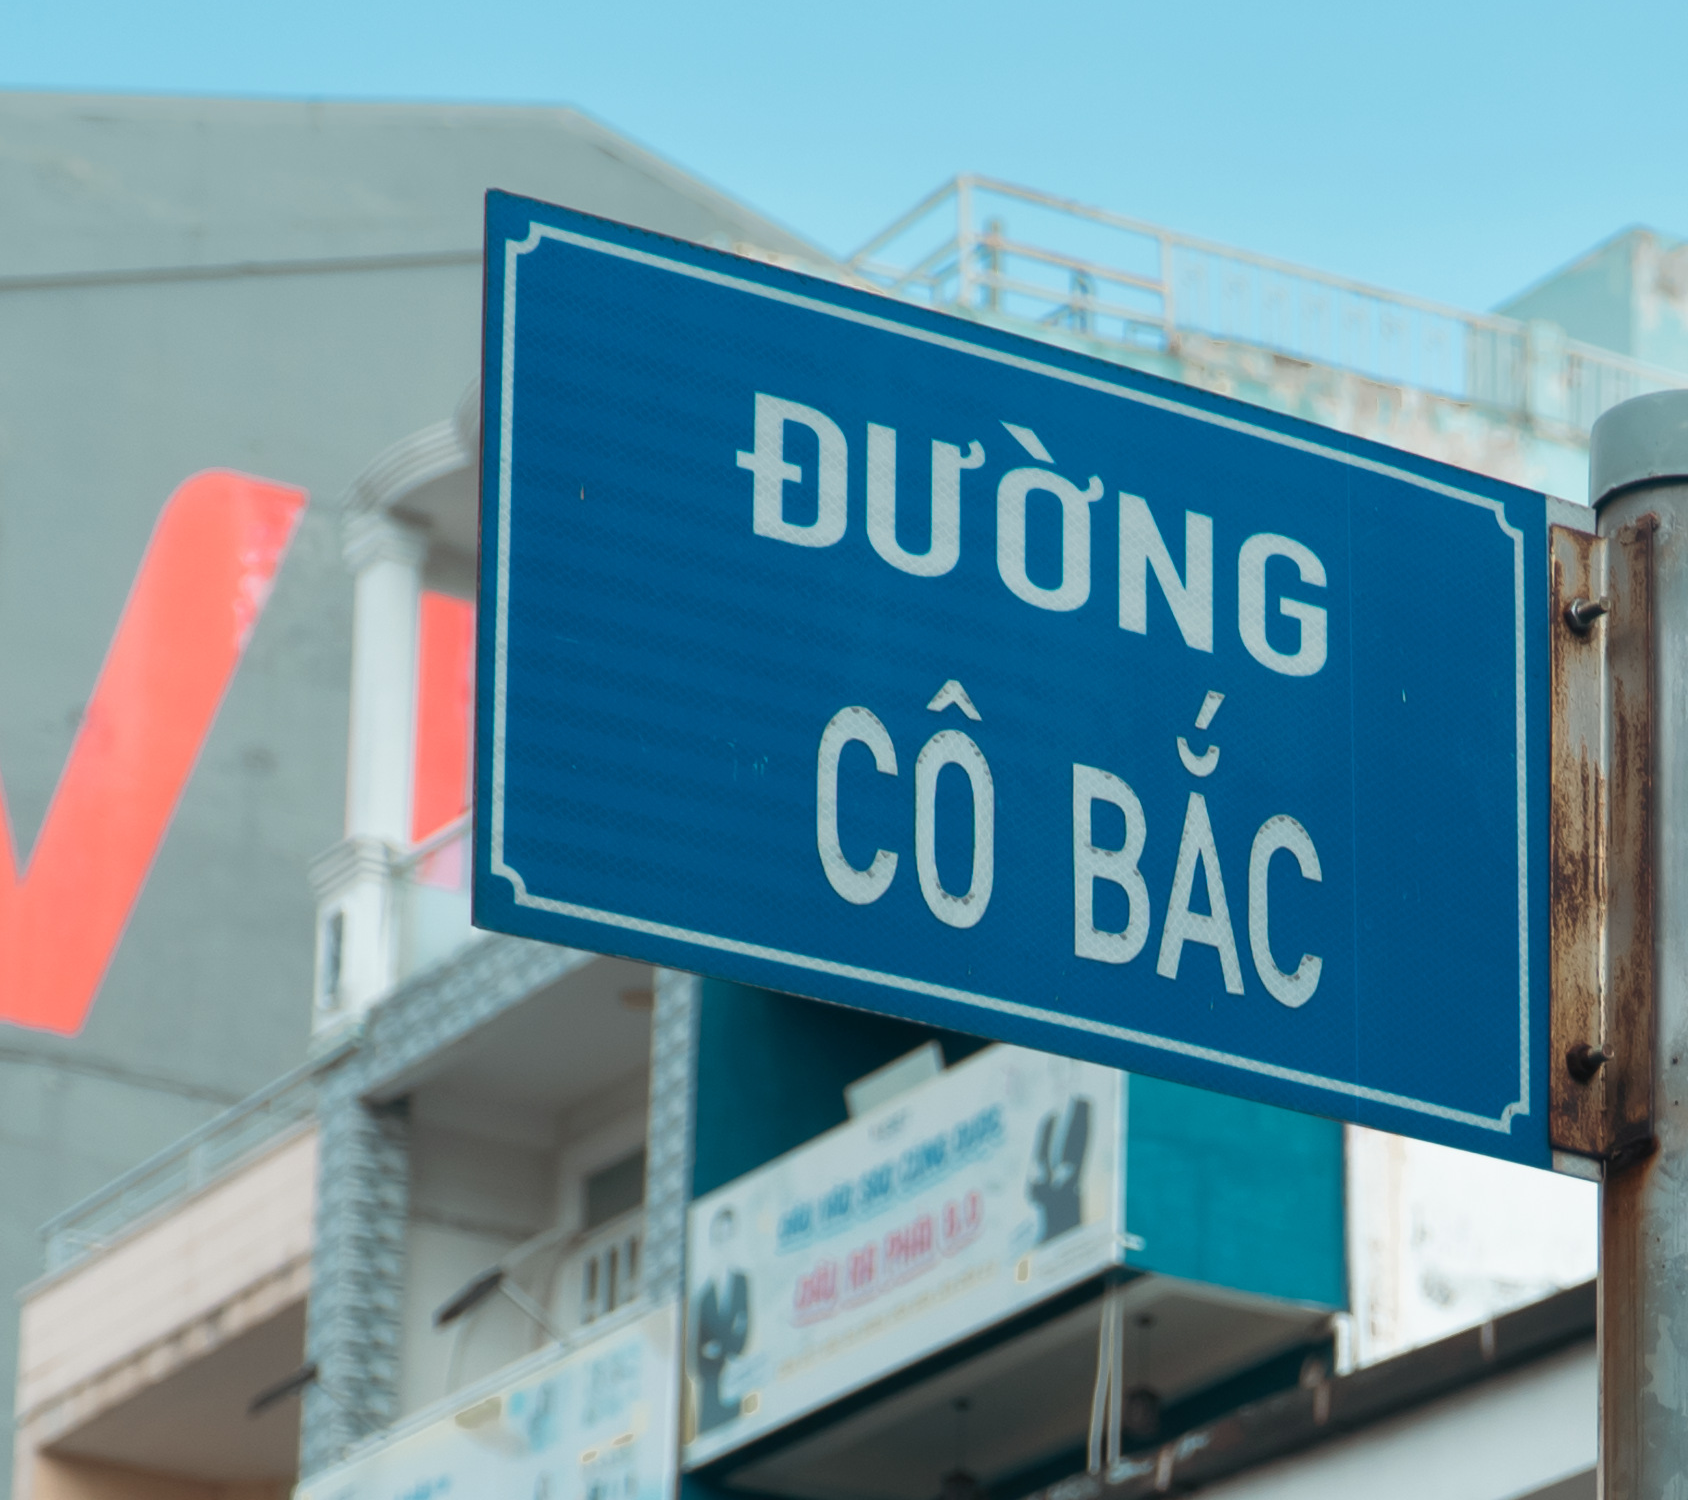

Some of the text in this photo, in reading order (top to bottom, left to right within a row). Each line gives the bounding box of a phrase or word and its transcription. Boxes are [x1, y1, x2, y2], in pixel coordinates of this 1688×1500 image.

[736, 392, 1328, 677] ĐƯỜNG
[817, 679, 1323, 1009] CÔ BẮC
